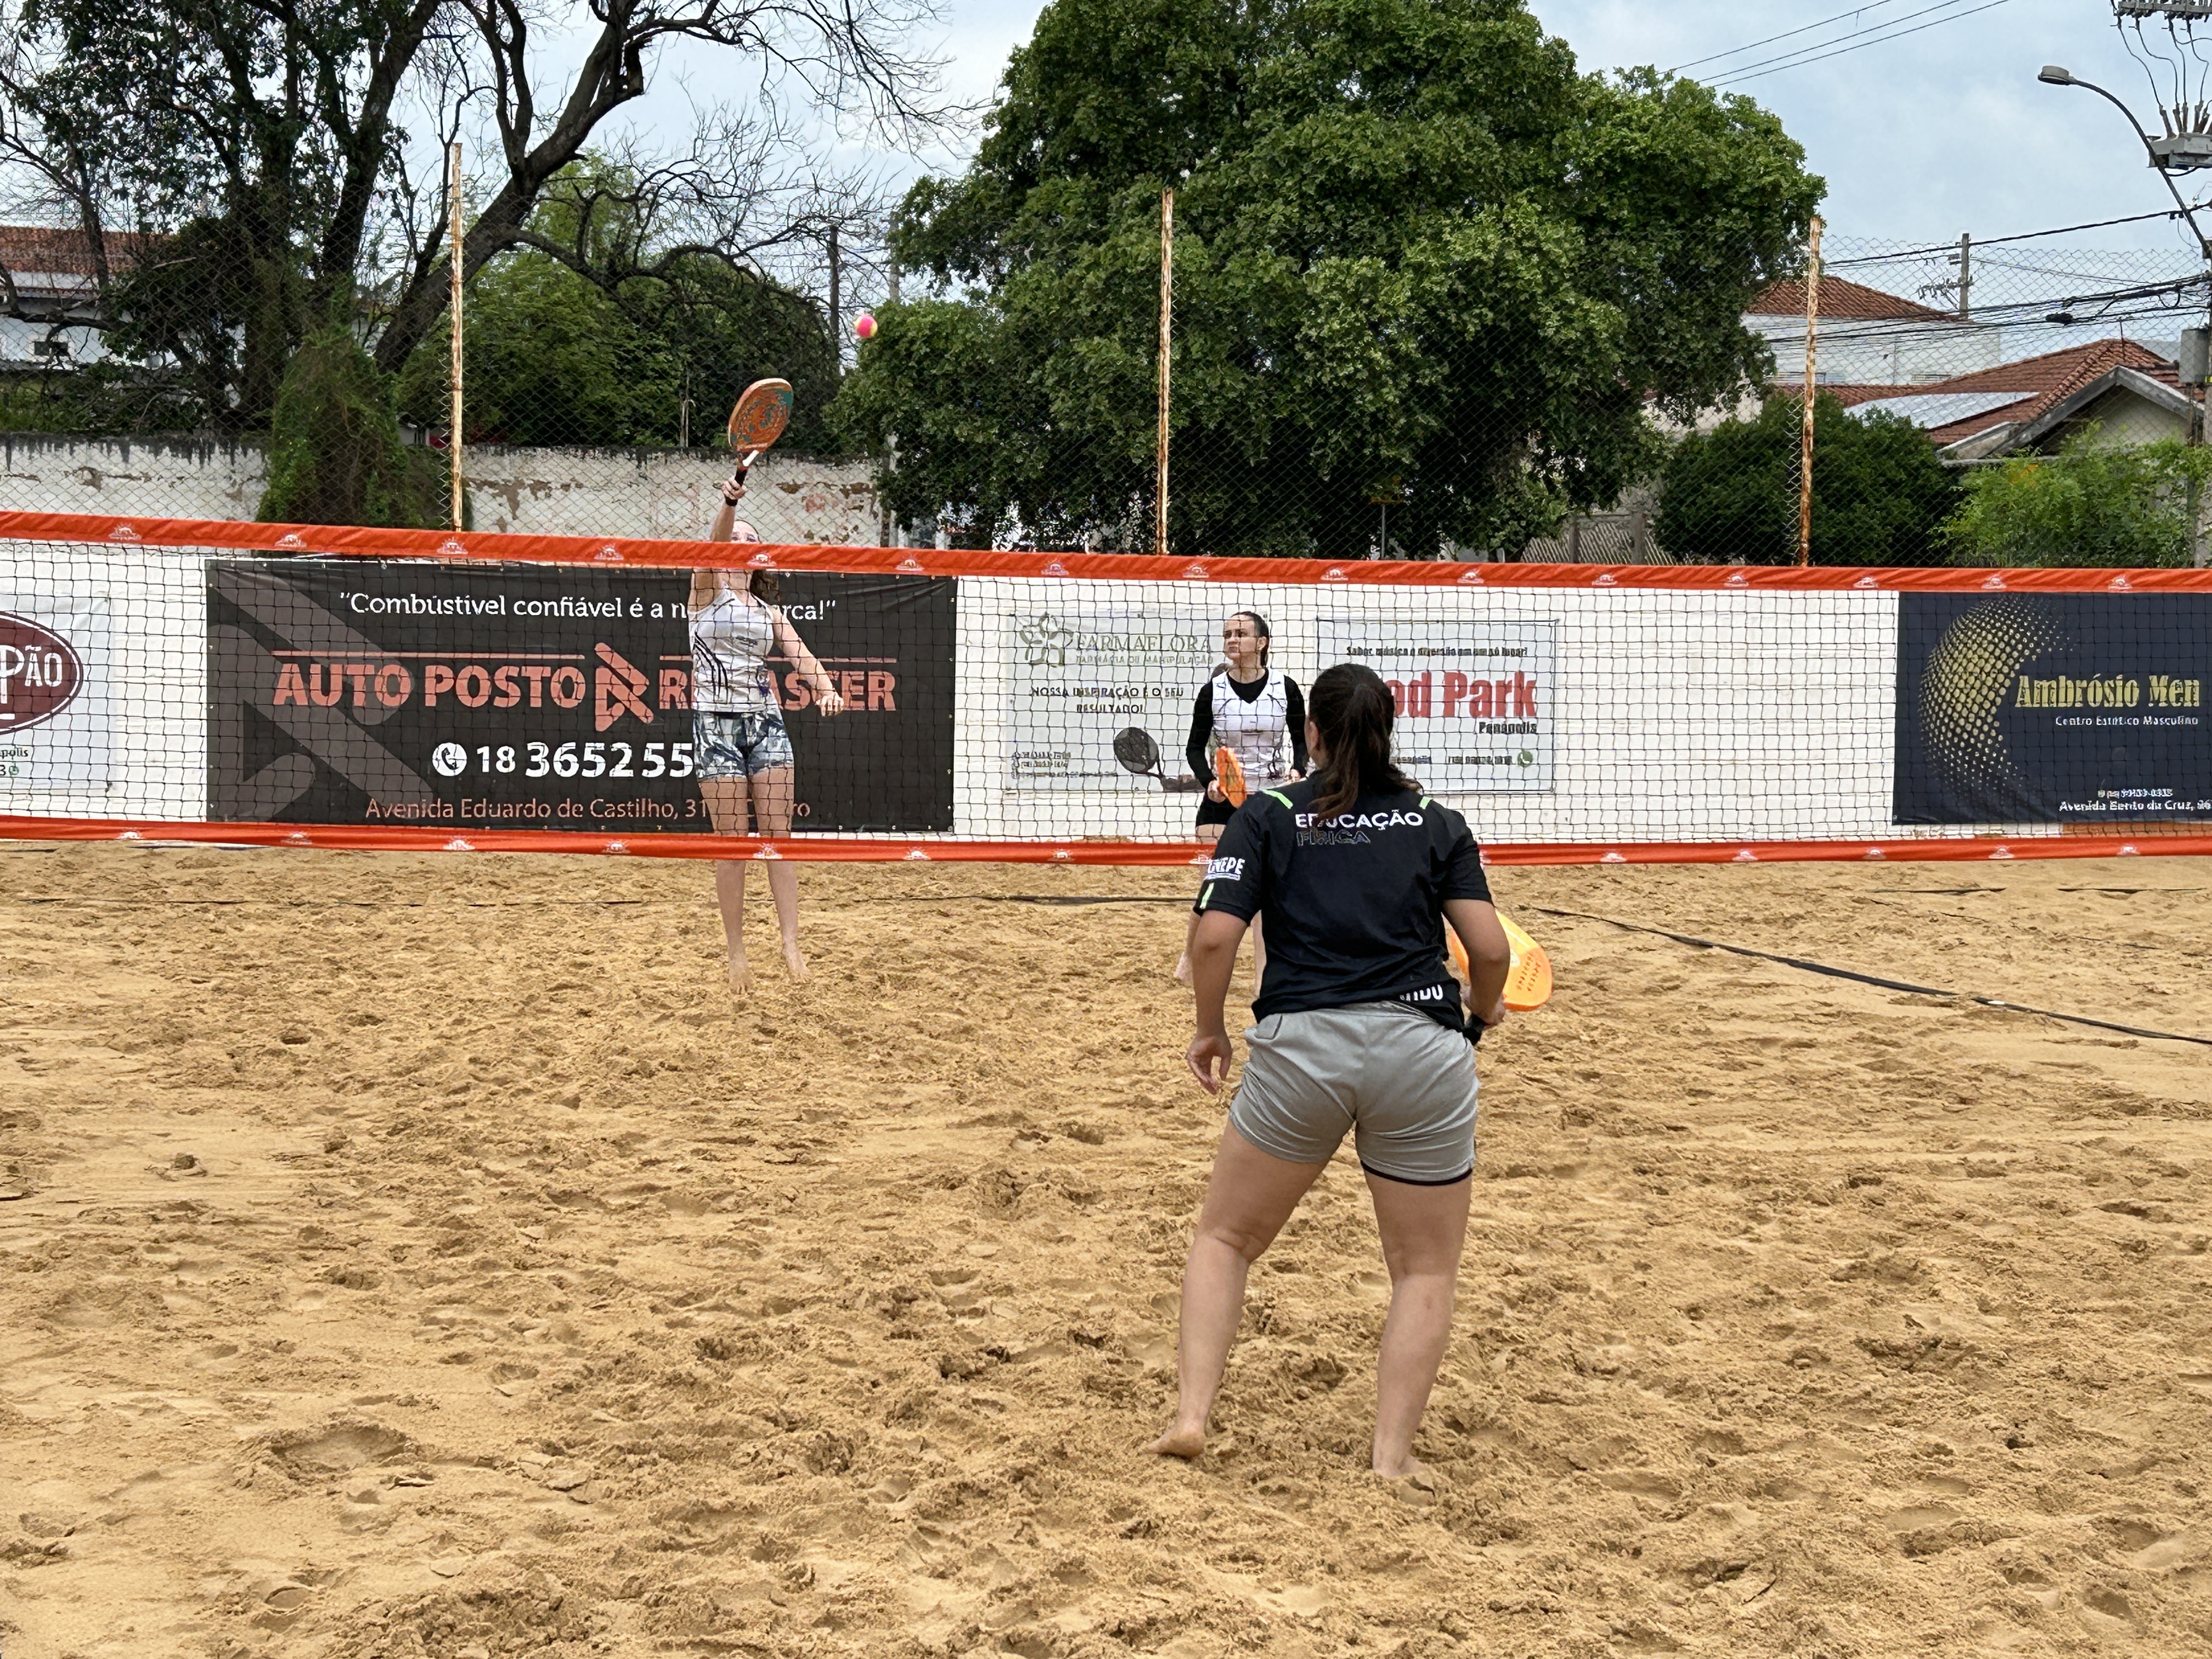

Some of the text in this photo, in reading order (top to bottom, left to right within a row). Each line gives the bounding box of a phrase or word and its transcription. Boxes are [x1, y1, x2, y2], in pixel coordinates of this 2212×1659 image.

[340, 592, 506, 616] "Combustível
[514, 596, 622, 618] confiável
[629, 599, 642, 618] é
[650, 603, 663, 619] a
[1076, 634, 1211, 652] FARMAFLORA
[273, 663, 411, 707] AUTO
[425, 665, 586, 708] POSTO
[1031, 686, 1069, 697] NOSSA
[1073, 685, 1138, 699] INSPIRAÇÃO
[1152, 687, 1161, 697] O
[1165, 687, 1184, 697] SEU
[1442, 670, 1537, 718] Park
[2015, 673, 2200, 708] Ambrósio Men
[1076, 704, 1143, 714] RESULTADO!
[2055, 715, 2199, 726] Centro Estético Masculino
[476, 741, 694, 778] 18 3652 55
[365, 798, 454, 819] Avenida
[461, 797, 551, 819] Eduardo
[557, 798, 583, 818] de
[589, 798, 679, 820] Castilho,
[2059, 800, 2106, 811] Avenida
[2109, 800, 2145, 810] Bento
[2147, 799, 2162, 810] da
[2164, 800, 2194, 811] Cruz,
